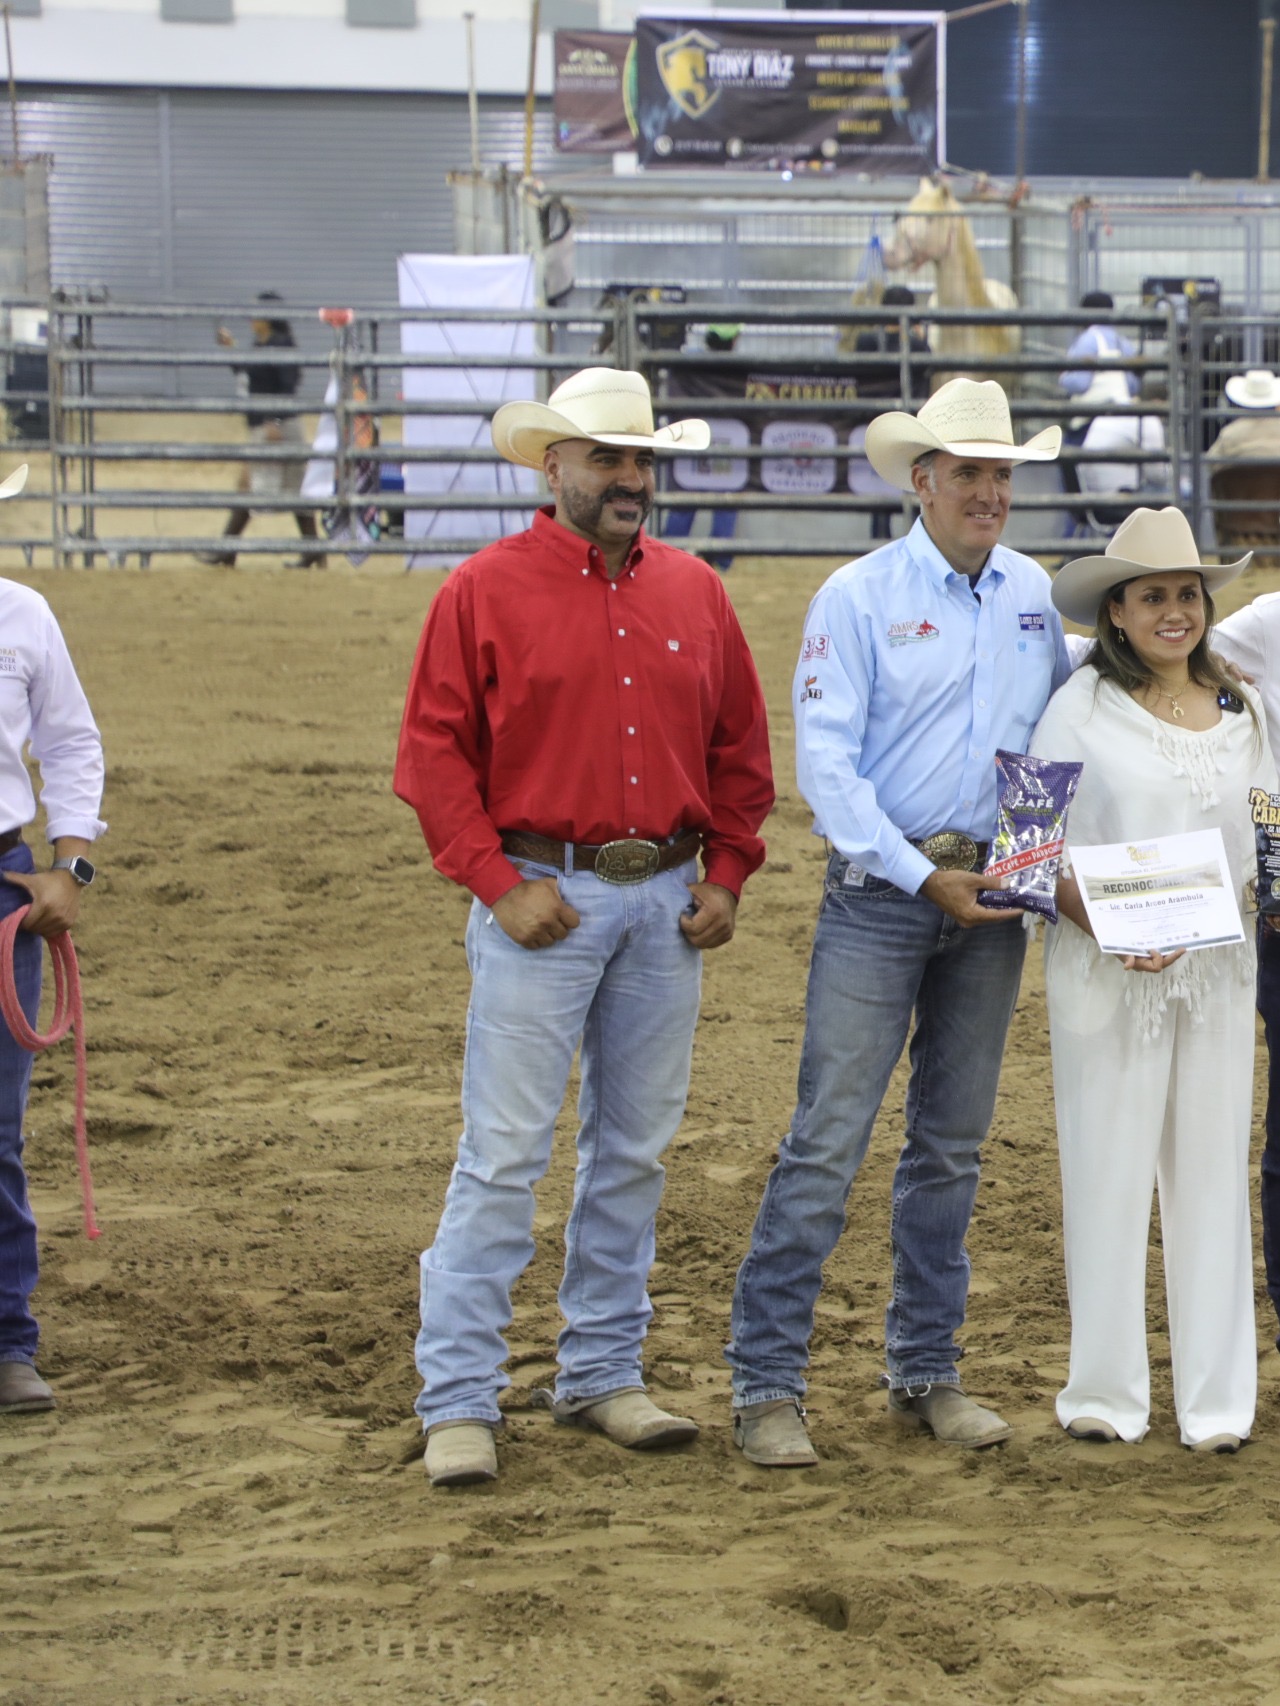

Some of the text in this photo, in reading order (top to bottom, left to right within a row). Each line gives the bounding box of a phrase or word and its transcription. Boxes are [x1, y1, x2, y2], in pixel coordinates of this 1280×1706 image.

[706, 53, 751, 79] TONY
[753, 54, 795, 80] DIAZ
[1016, 796, 1054, 808] CAFÉ
[1124, 902, 1143, 910] Carla
